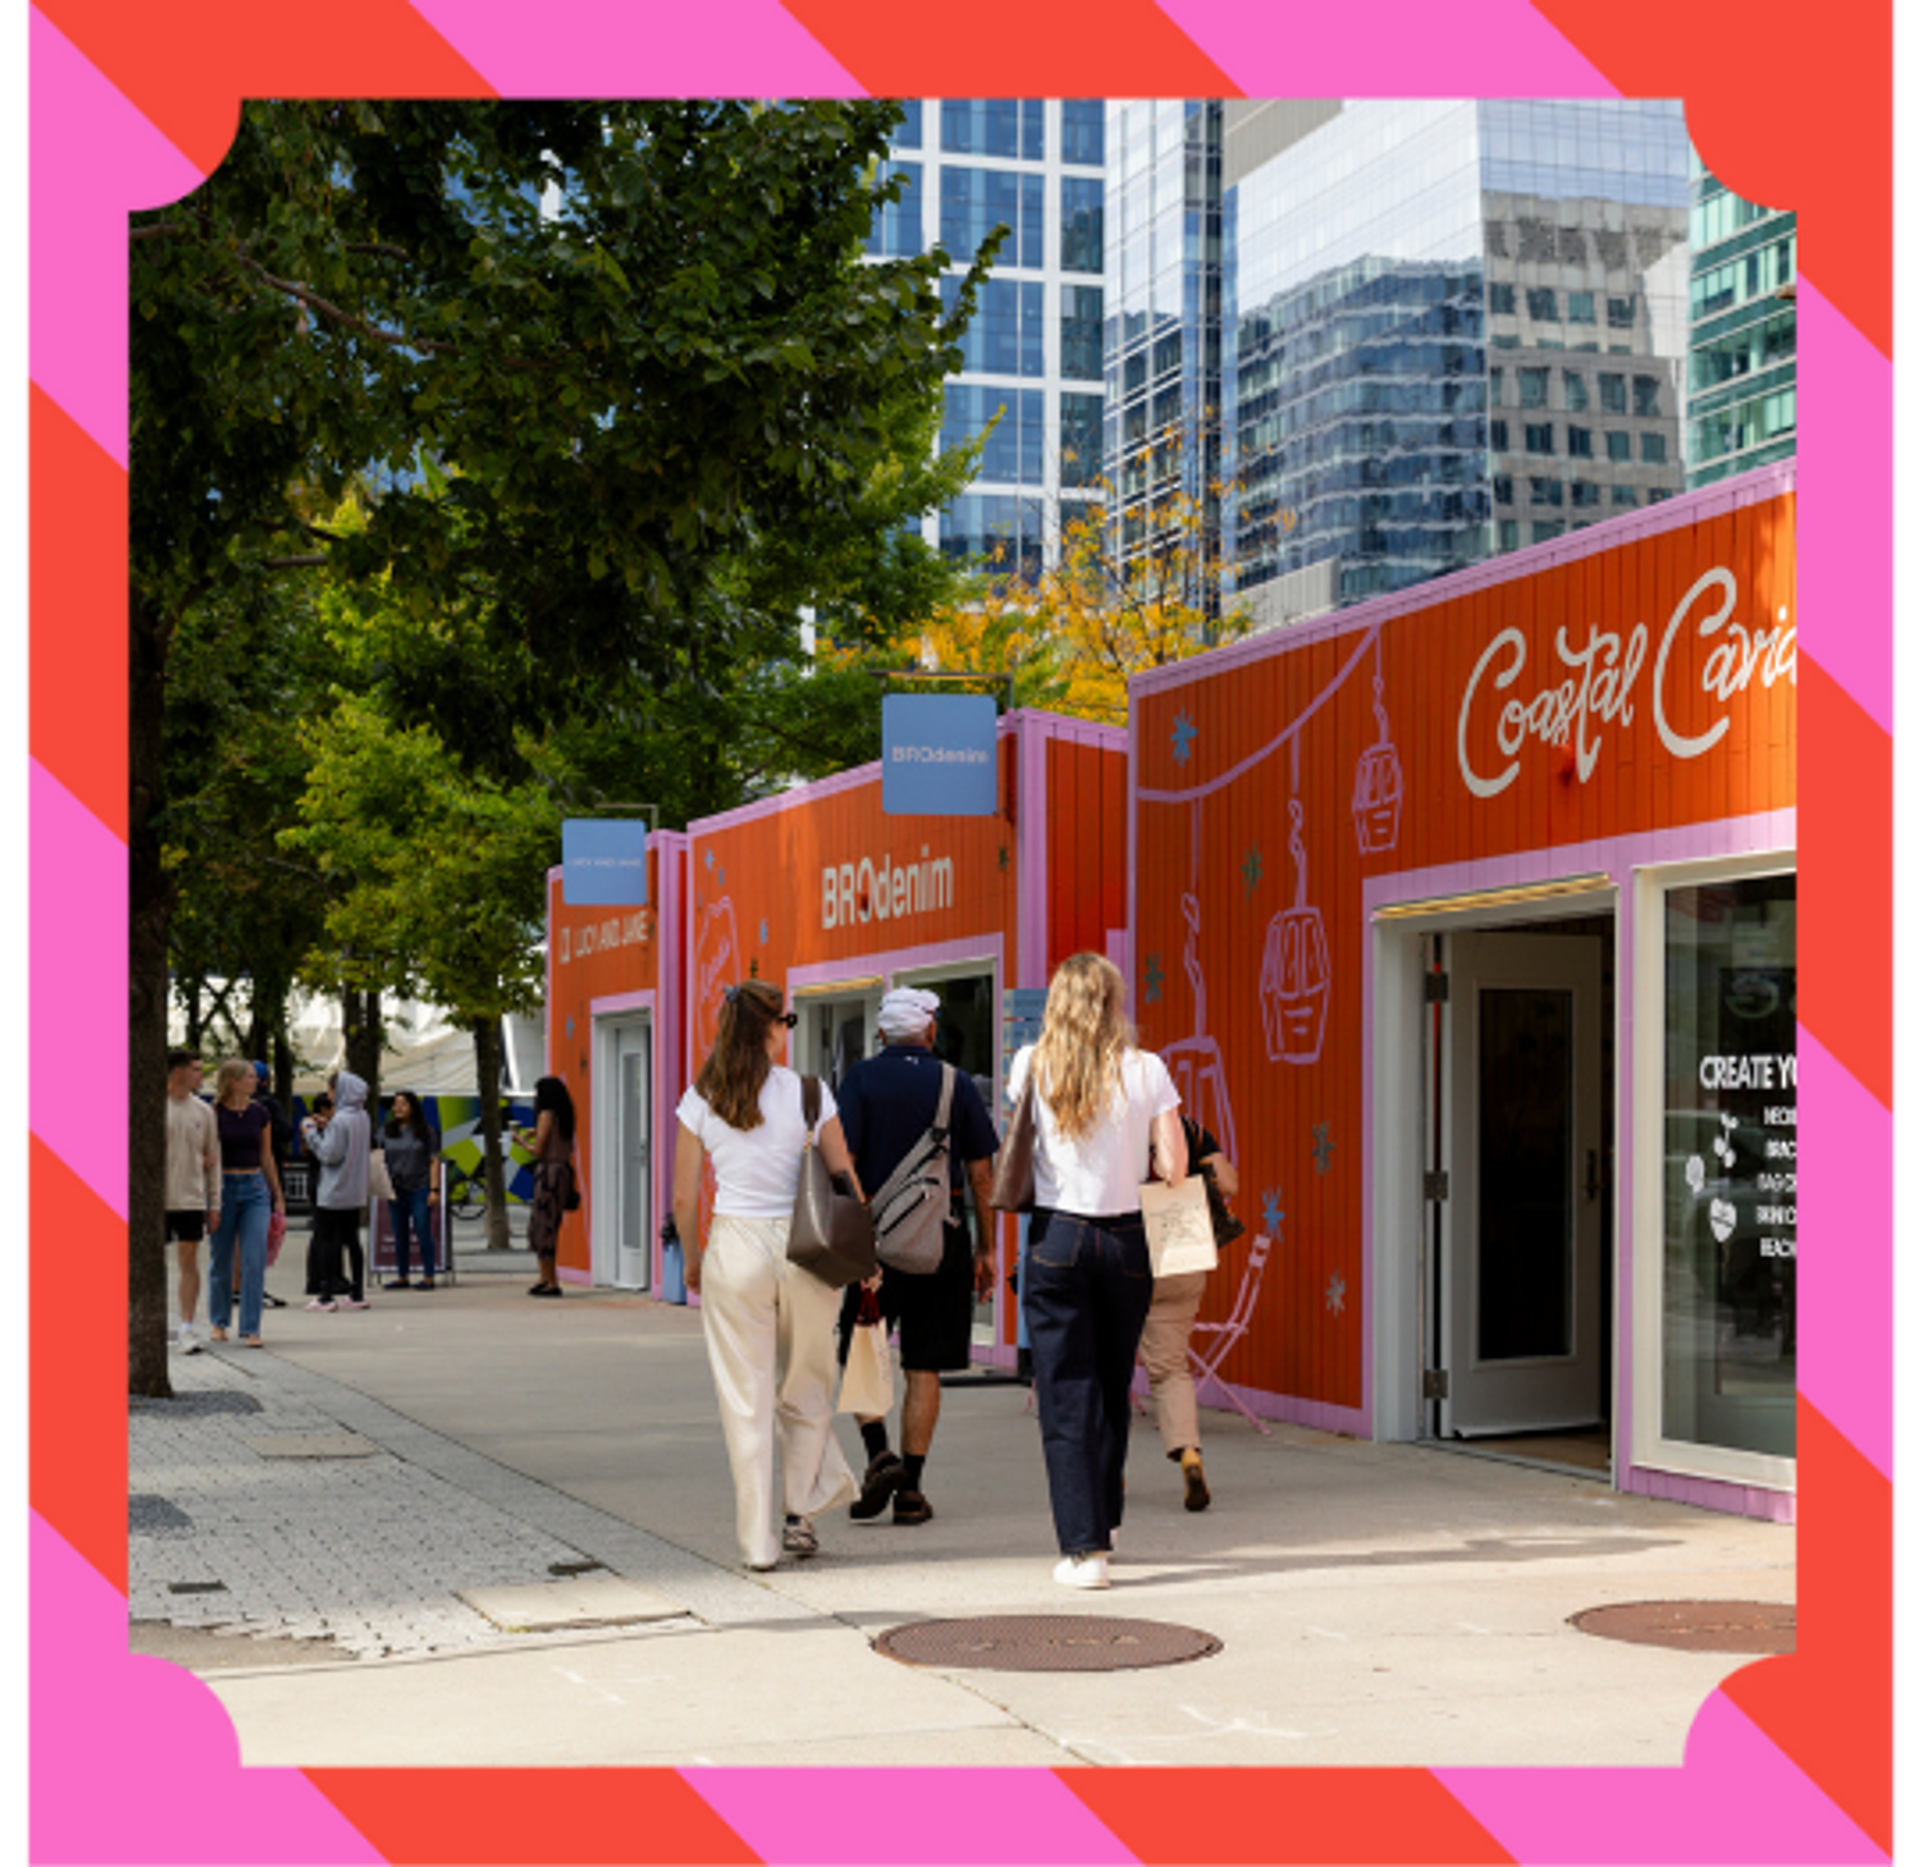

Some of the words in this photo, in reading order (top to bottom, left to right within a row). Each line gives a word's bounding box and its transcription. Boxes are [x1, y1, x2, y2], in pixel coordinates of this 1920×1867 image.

[1457, 622, 1648, 798] Coastal
[891, 746, 989, 763] BROdenim
[821, 843, 954, 929] BROdenim
[1699, 1055, 1773, 1089] CREATE
